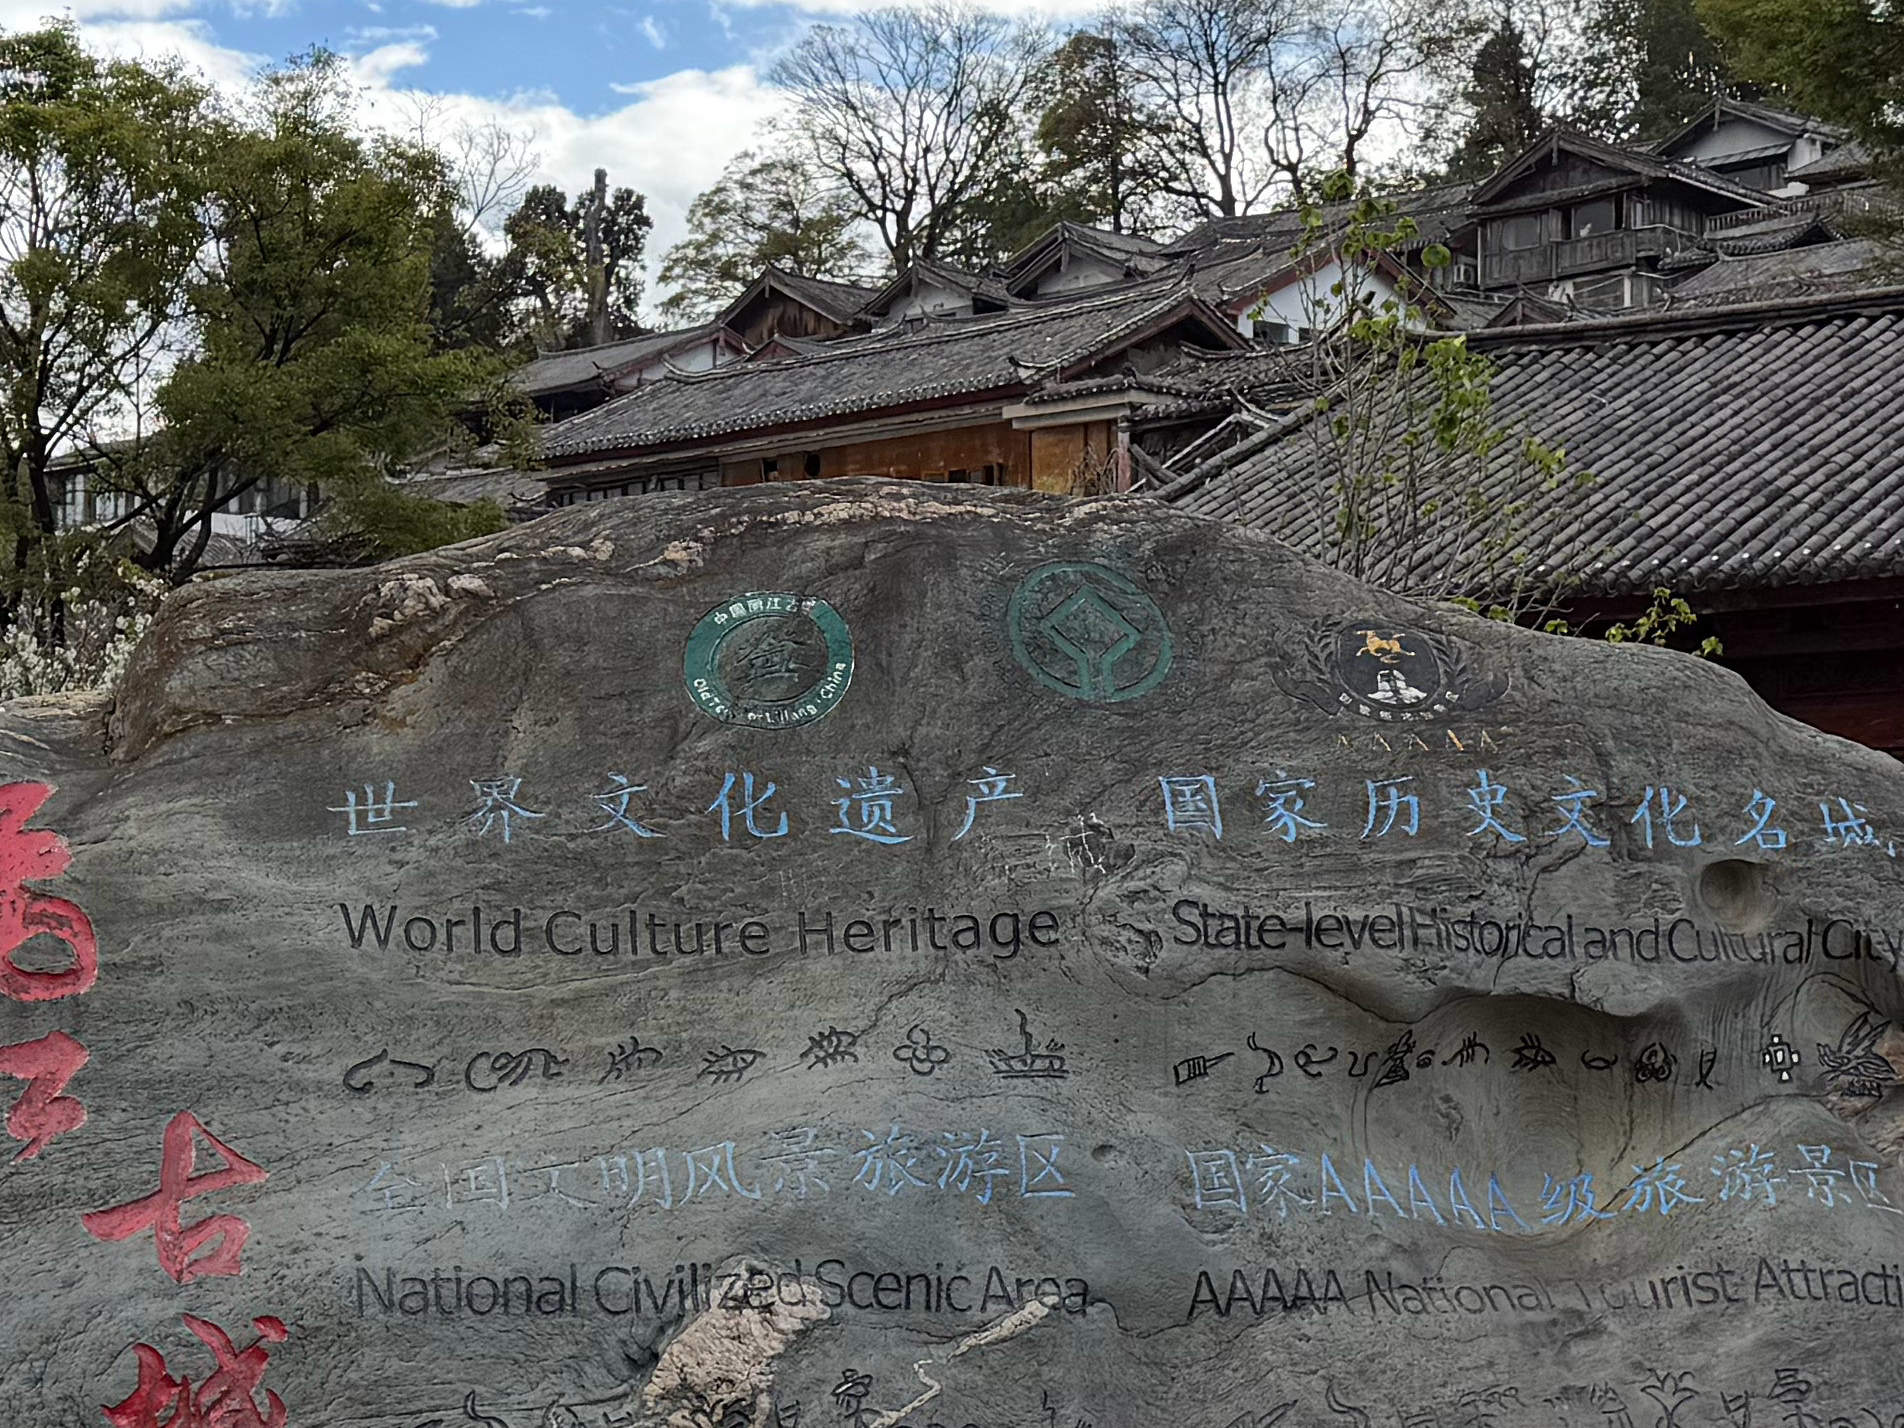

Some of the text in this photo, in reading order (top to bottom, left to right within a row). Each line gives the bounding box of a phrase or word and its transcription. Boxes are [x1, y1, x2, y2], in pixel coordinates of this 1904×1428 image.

[327, 766, 1025, 845] 世界文化遗产
[1158, 769, 1897, 857] 国家历史文化名城
[336, 902, 1060, 959] World Culture Heritage
[1171, 899, 1902, 972] State-level Historical and Cultural City
[353, 1126, 1077, 1215] 全国文明风景旅游区
[1185, 1142, 1904, 1231] 国家AAAAA级旅游景区
[355, 1258, 1091, 1317] National Civilized Scenic Area
[1186, 1268, 1356, 1321] AAAAA
[1365, 1269, 1556, 1318] National
[1557, 1261, 1743, 1311] Tourist
